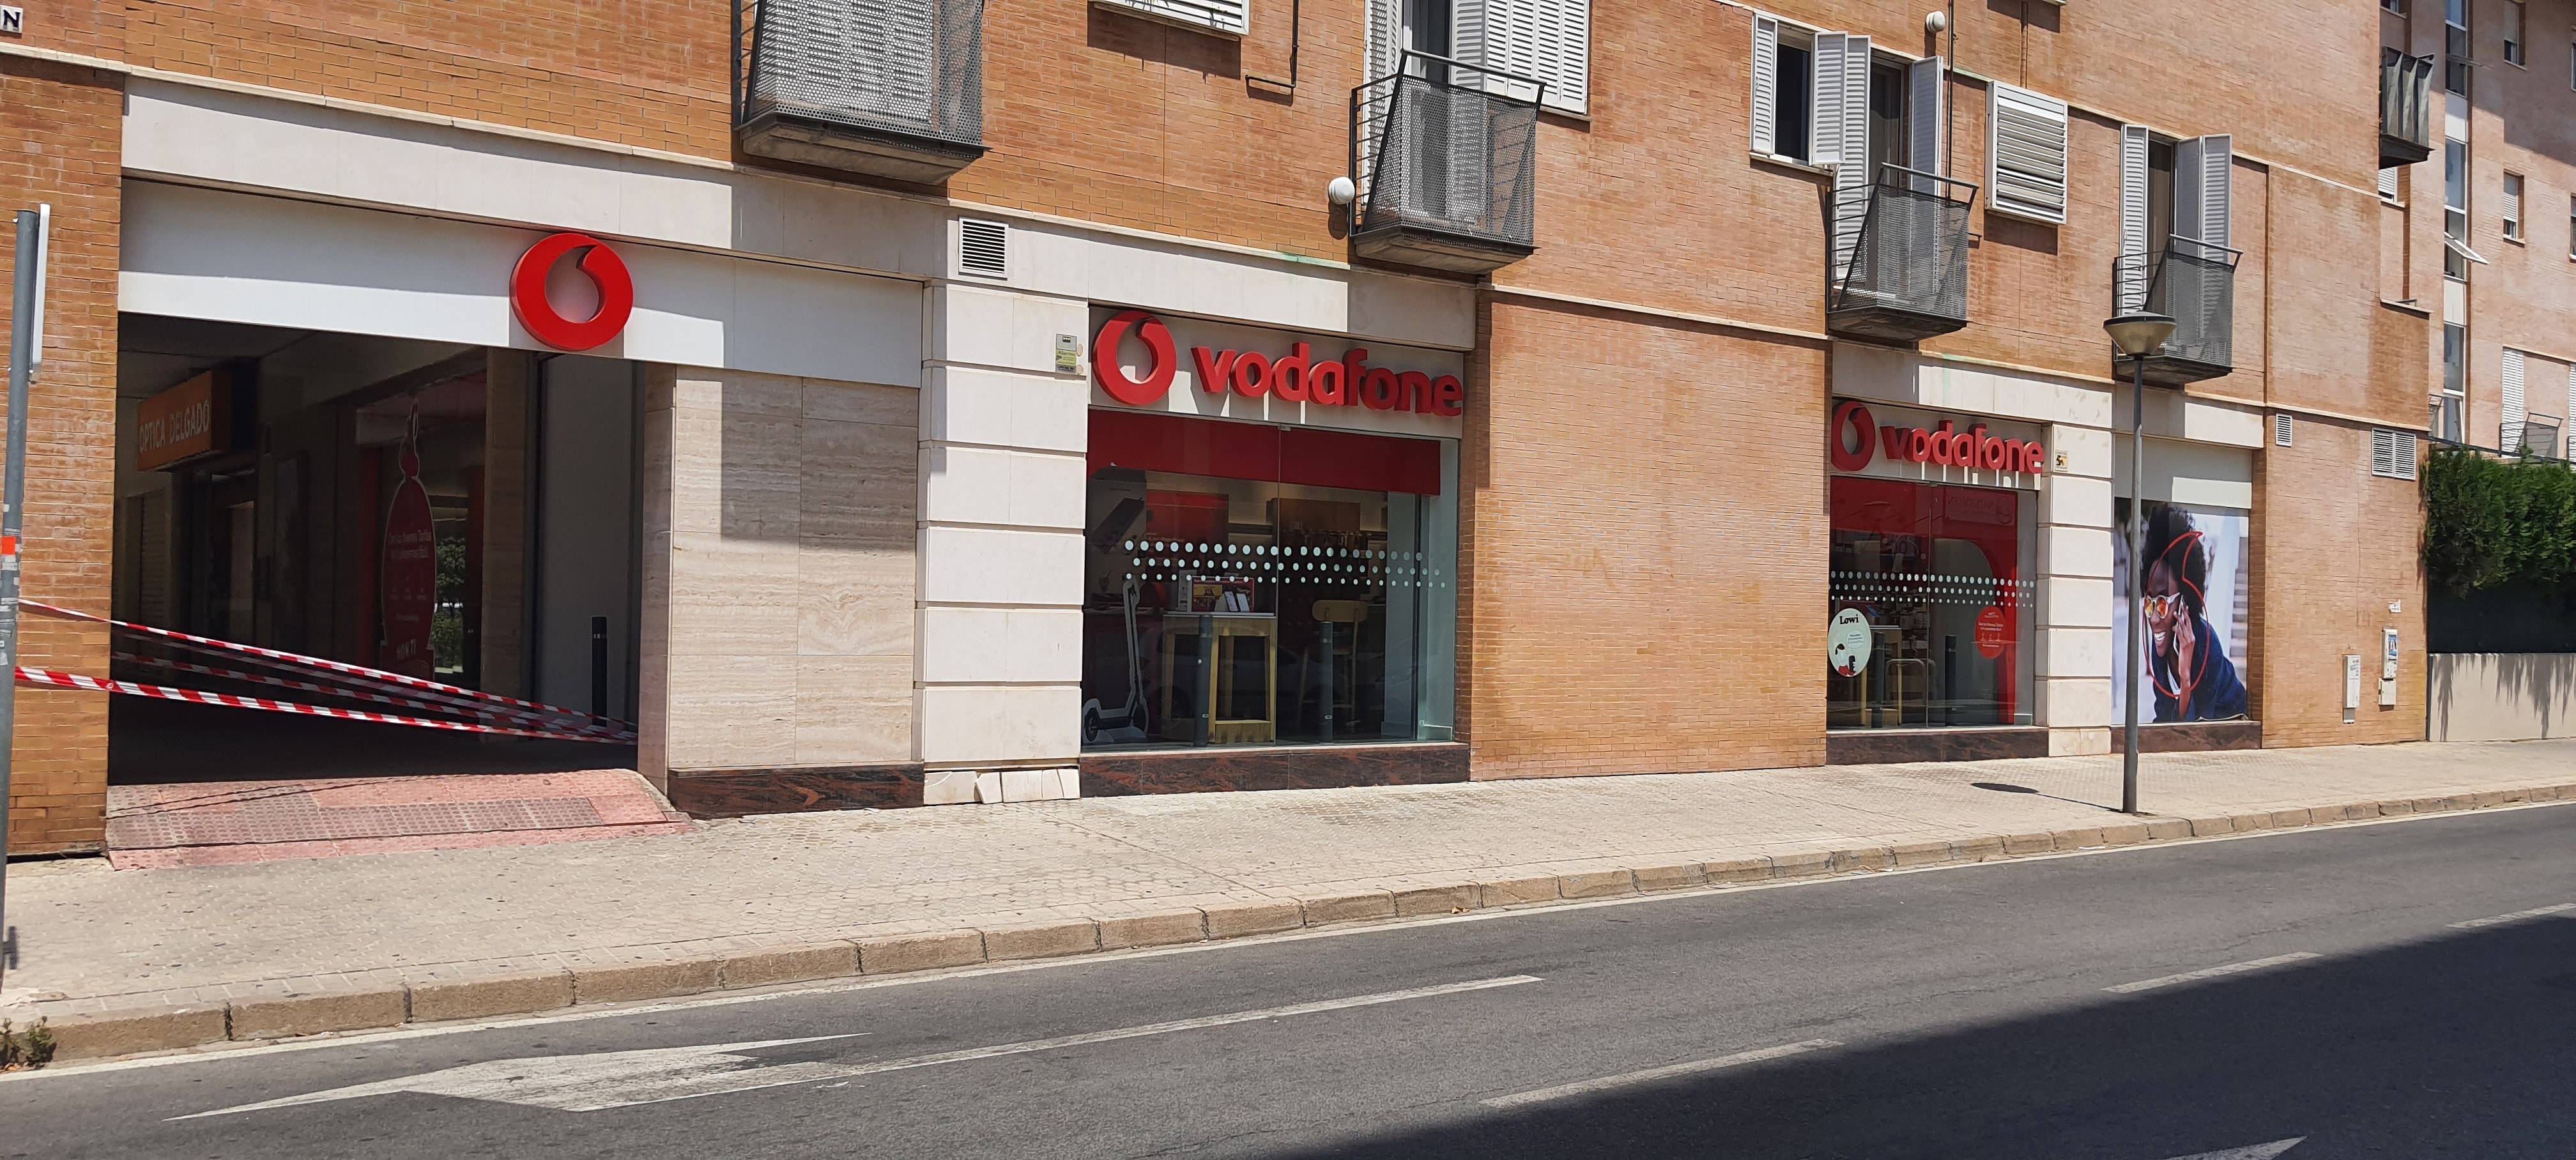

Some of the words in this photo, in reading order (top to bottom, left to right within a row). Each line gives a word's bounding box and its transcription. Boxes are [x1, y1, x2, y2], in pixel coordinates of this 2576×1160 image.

[3, 9, 20, 28] N
[1191, 342, 1462, 417] vodafone
[1880, 420, 2044, 473] vodafone
[1839, 613, 1859, 624] Lowi
